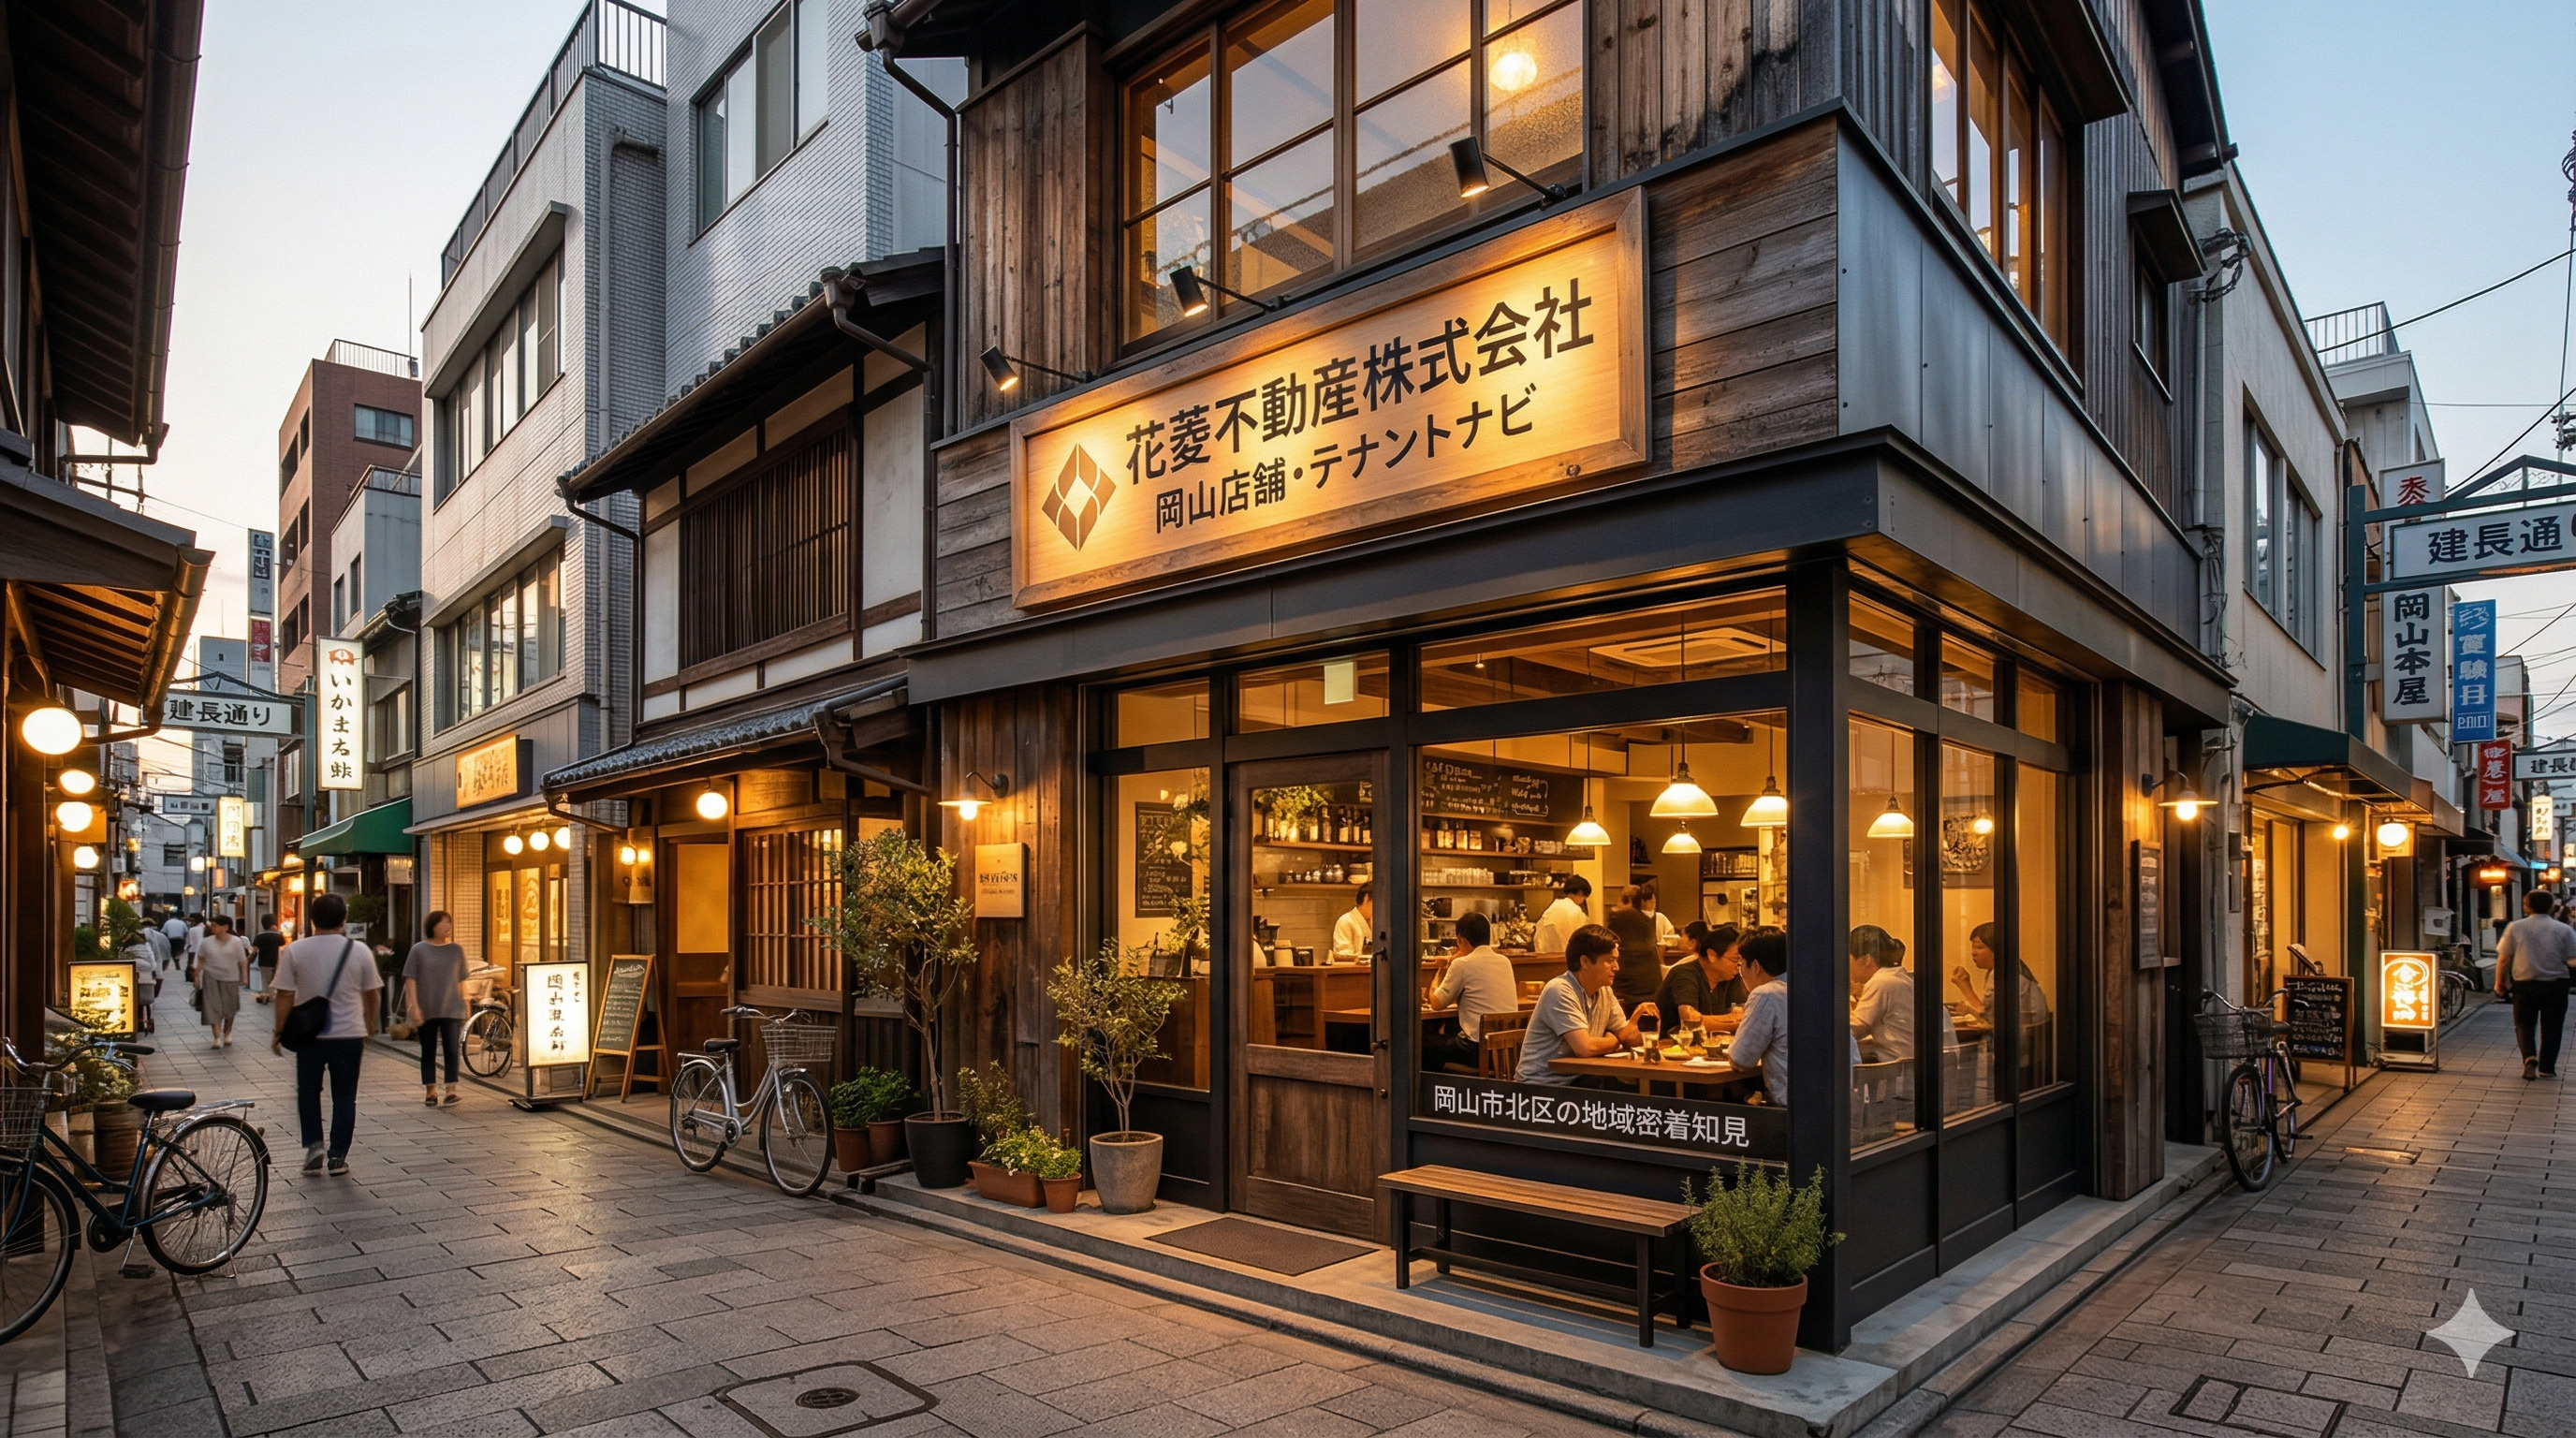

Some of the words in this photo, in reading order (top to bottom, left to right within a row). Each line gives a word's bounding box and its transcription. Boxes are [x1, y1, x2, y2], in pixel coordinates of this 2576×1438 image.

[1126, 277, 1594, 484] 花菱不動産株式会社
[1156, 383, 1538, 533] 岡山店舗・テナントナビ
[2393, 593, 2431, 705] 岡山本屋
[164, 697, 270, 726] 建長通り
[1433, 1084, 1749, 1148] 岡山市北区の地域密着知見
